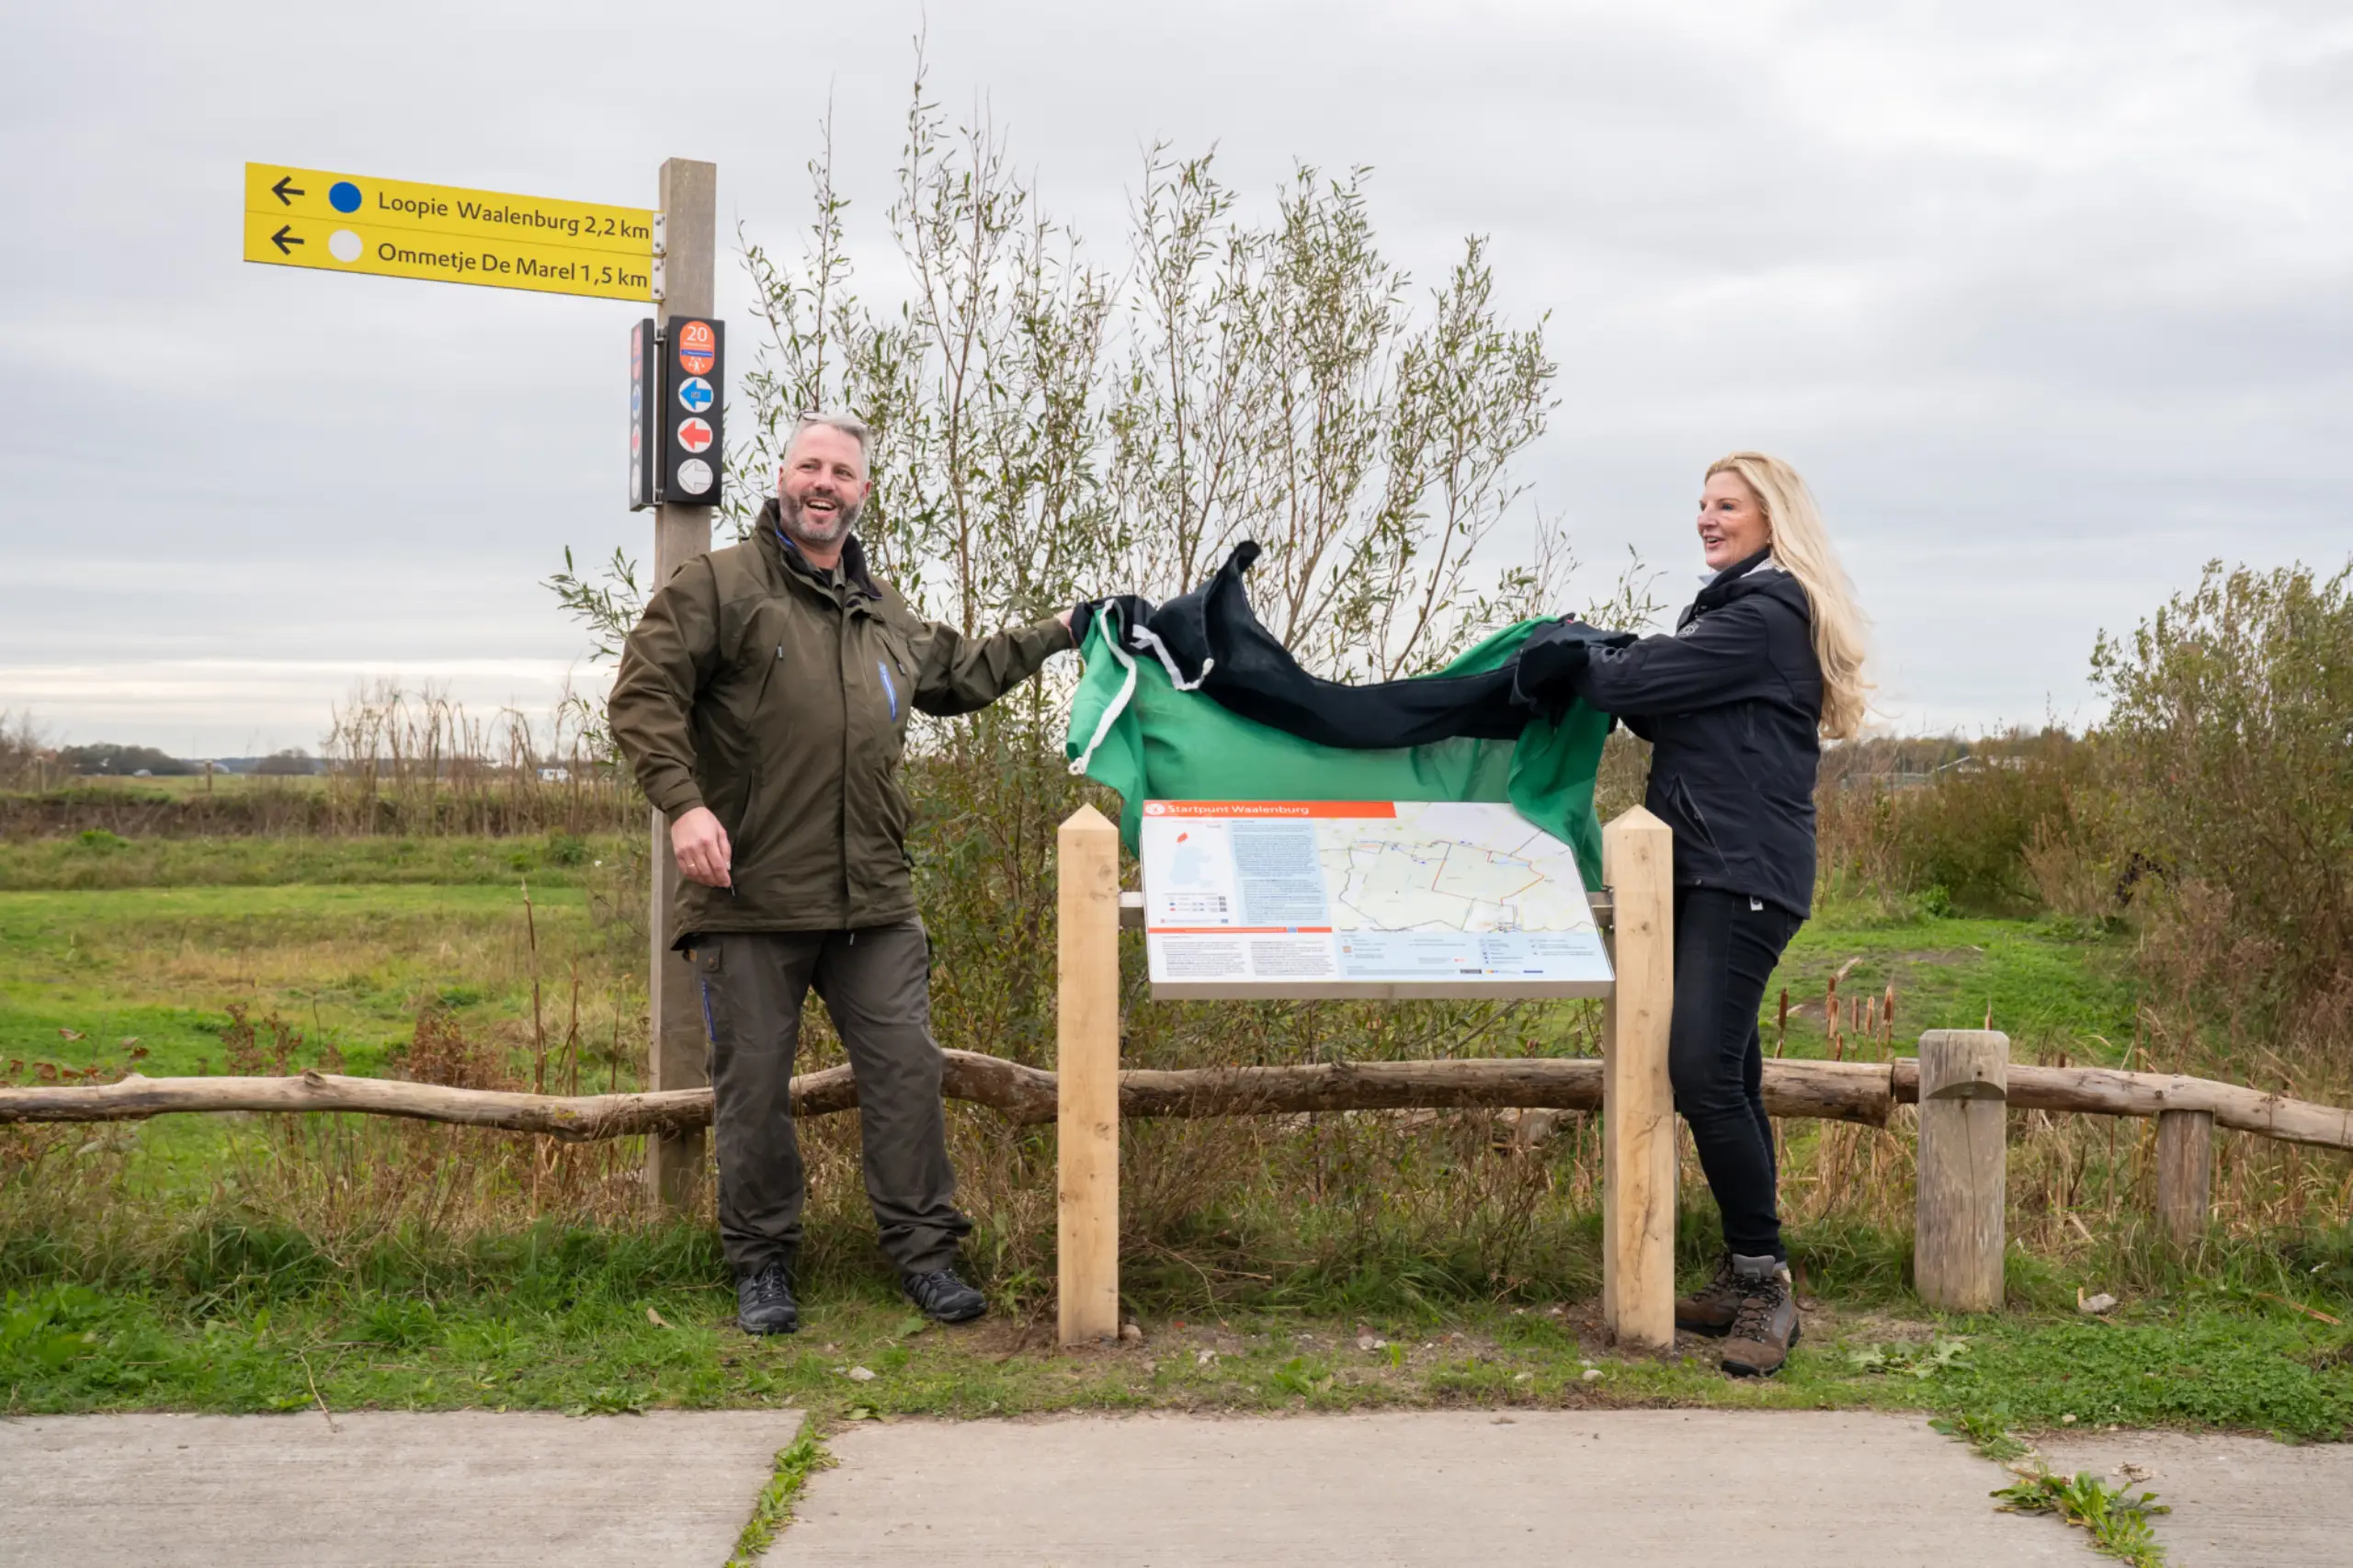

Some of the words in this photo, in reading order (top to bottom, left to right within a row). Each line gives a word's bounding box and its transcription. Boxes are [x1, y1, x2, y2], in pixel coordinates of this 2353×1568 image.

[378, 191, 449, 219] Loopie
[456, 200, 580, 236] Waalenburg
[584, 216, 616, 237] 2,2
[620, 220, 650, 240] km
[378, 243, 477, 273] Ommetje
[482, 254, 511, 274] De
[516, 257, 575, 281] Marel
[580, 265, 613, 289] 1,5
[618, 267, 649, 289] km
[687, 325, 708, 342] 20
[1168, 802, 1229, 814] Startpunt
[1231, 803, 1310, 815] Waalenburg
